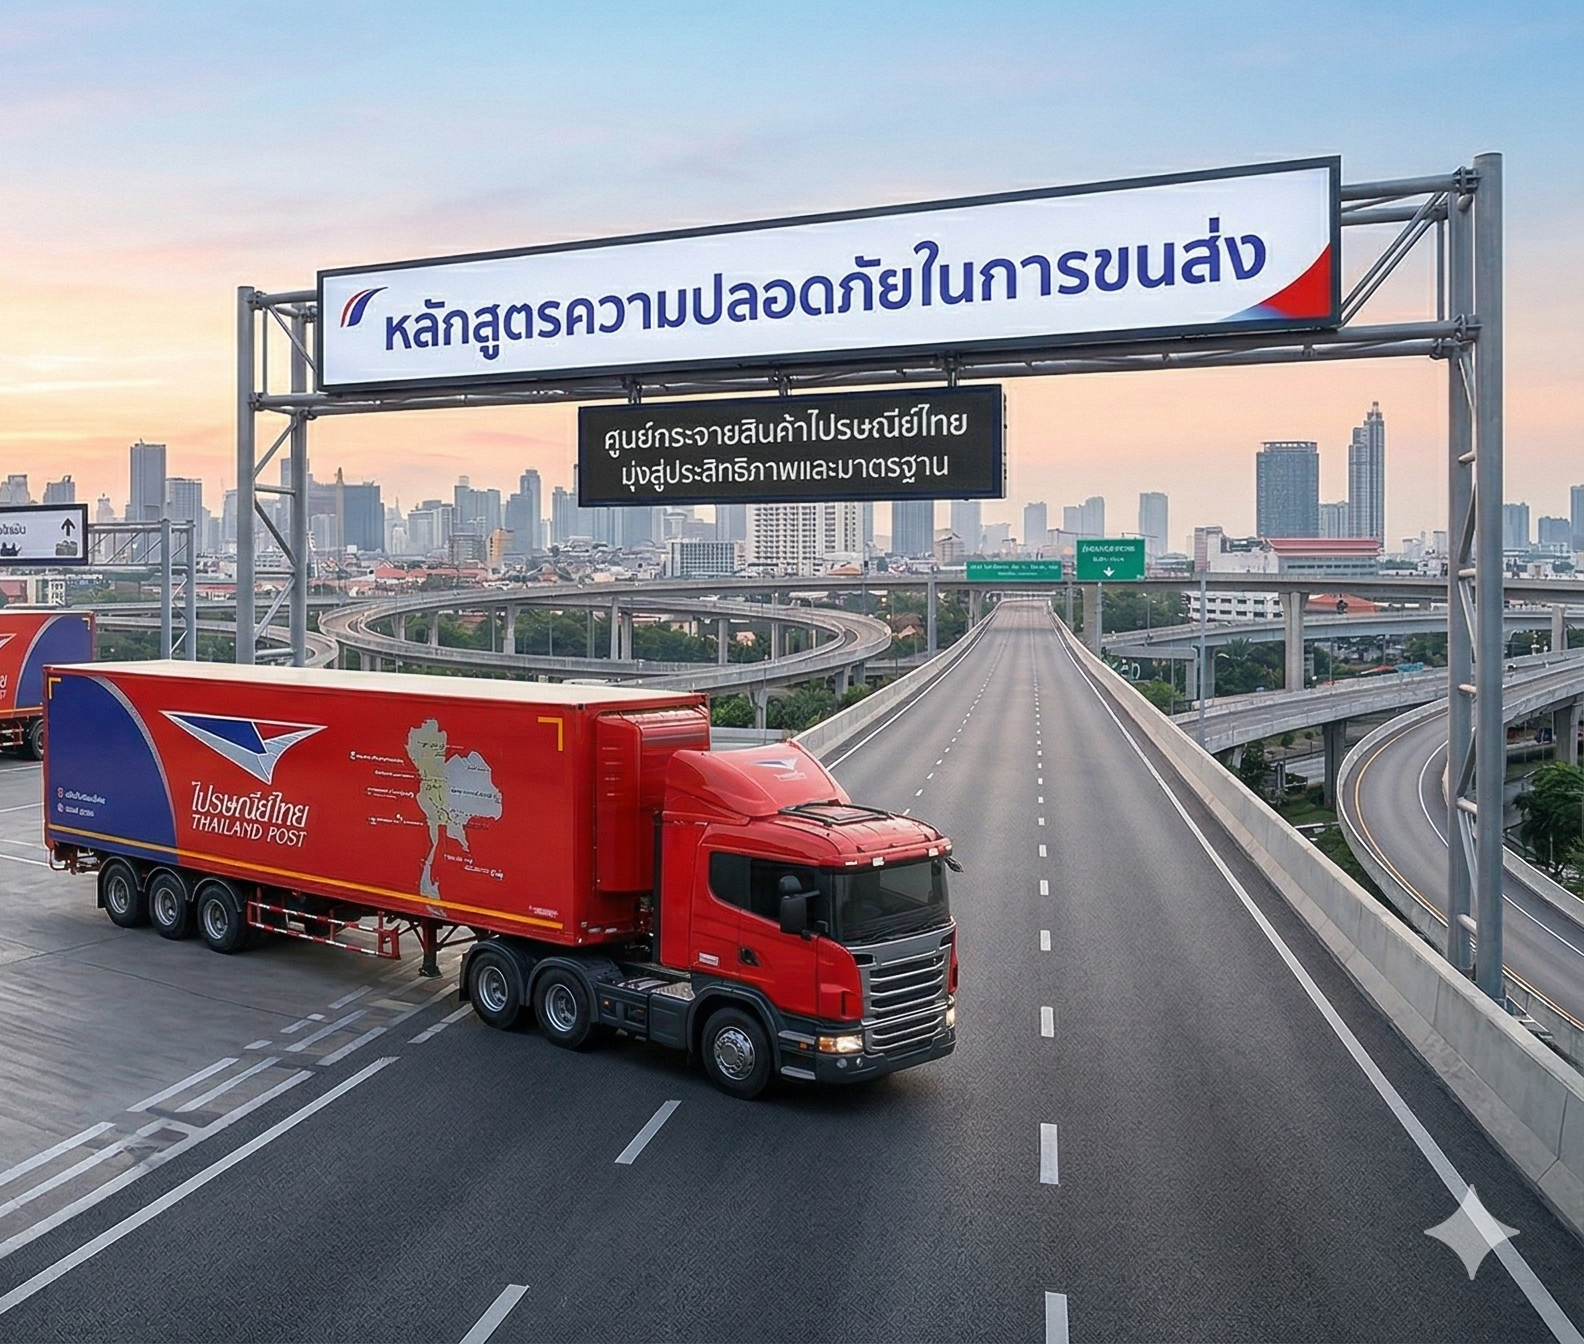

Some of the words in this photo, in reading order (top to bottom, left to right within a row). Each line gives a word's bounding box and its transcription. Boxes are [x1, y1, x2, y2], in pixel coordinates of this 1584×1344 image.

[385, 217, 1267, 361] หลักสูตรความปลอดภัยในการขนส่ง
[604, 403, 968, 458] ศูนย์กระจายสินค้าไปรษณีย์ไทย
[622, 455, 949, 493] มุ่งสู่ประสิทธิภาพและมาตรฐาน
[191, 781, 309, 828] ไปรษณีย์ไทย
[192, 814, 263, 840] THAILAND
[267, 826, 307, 848] POST
